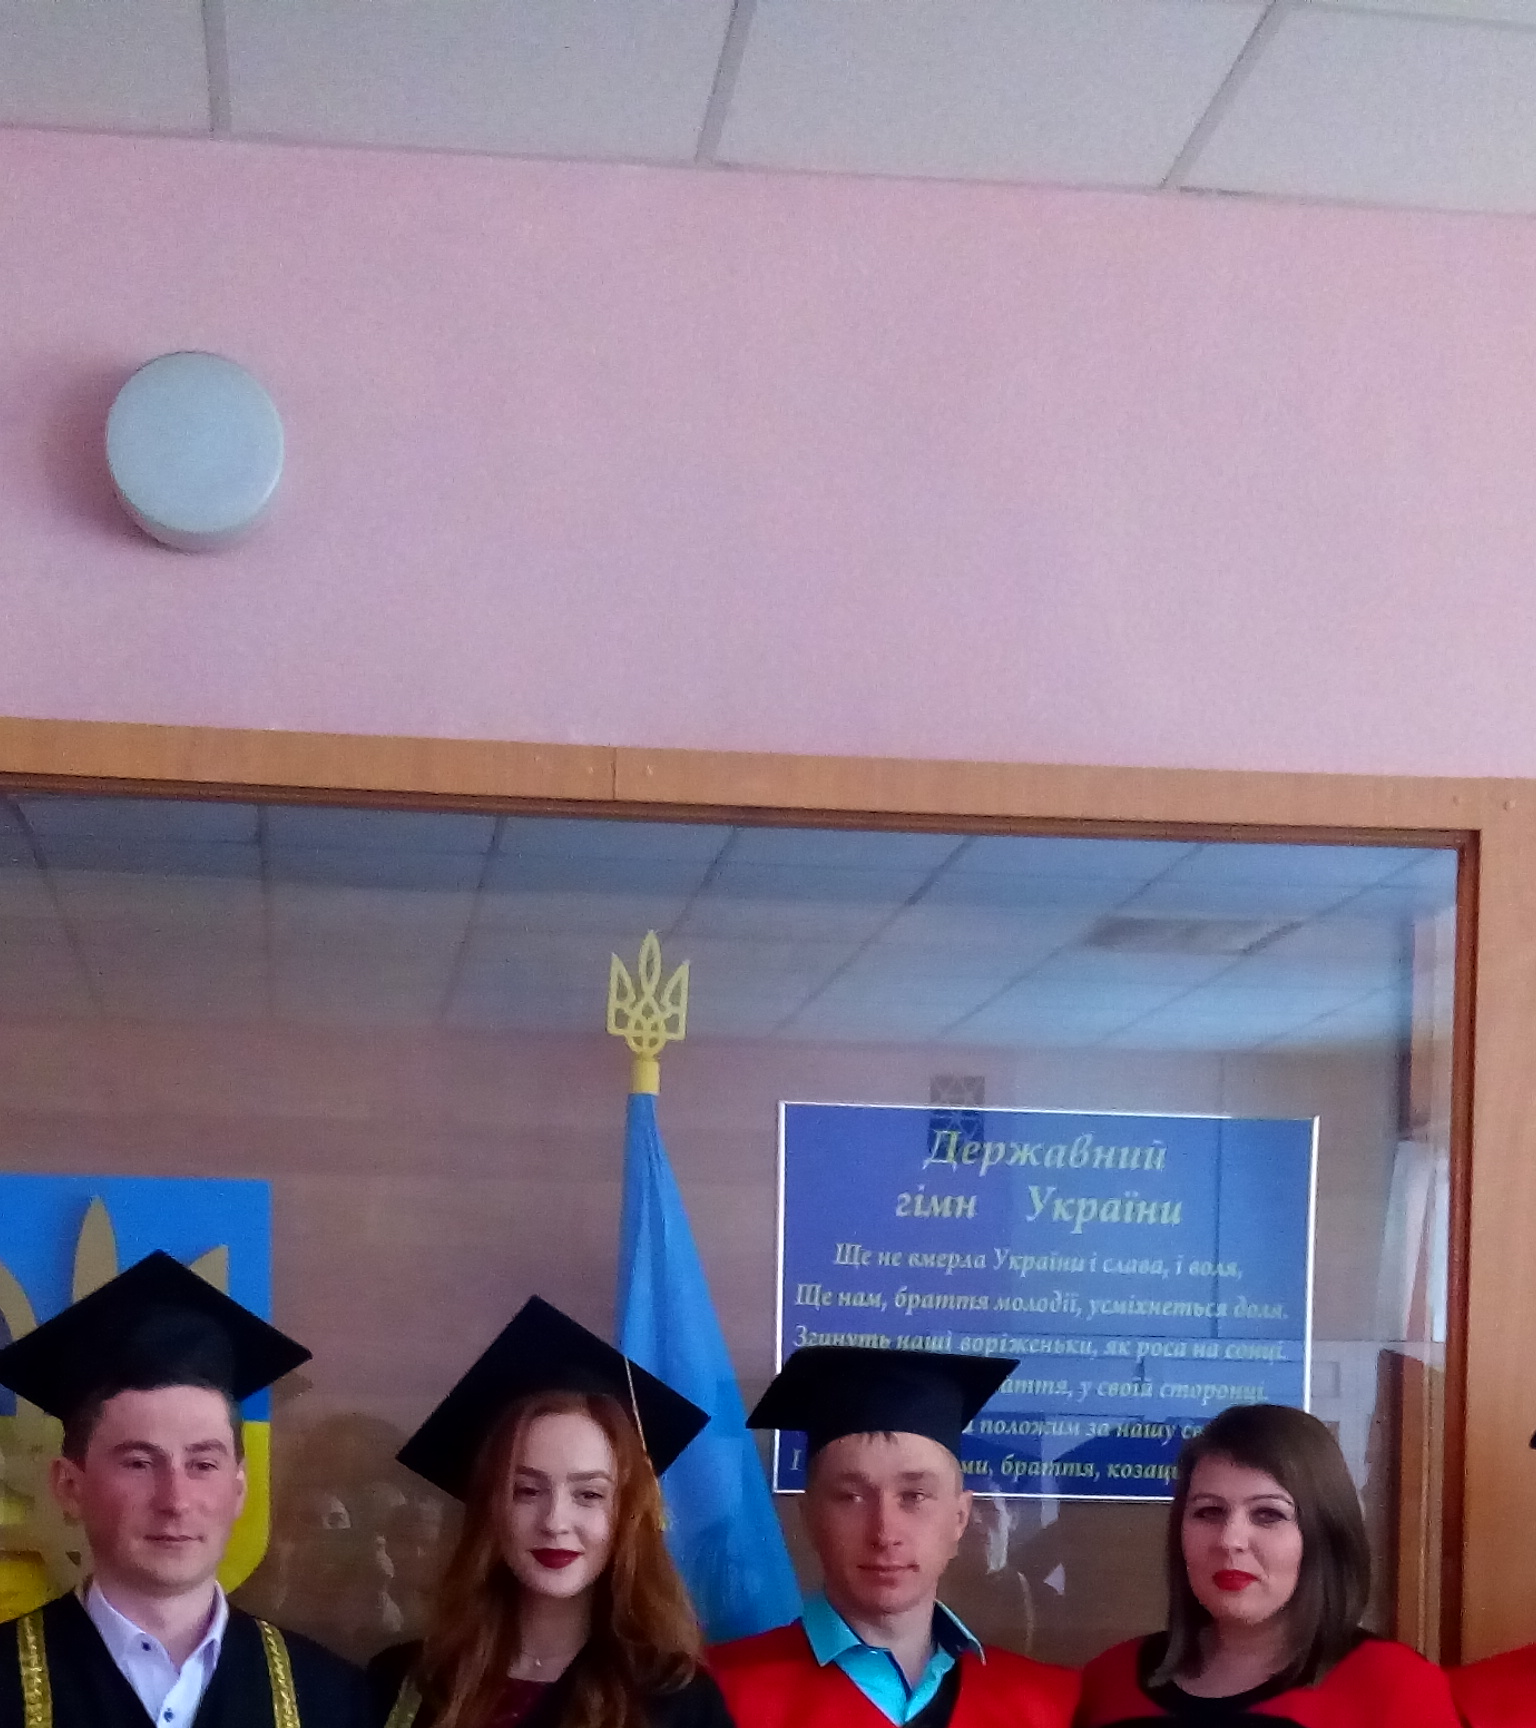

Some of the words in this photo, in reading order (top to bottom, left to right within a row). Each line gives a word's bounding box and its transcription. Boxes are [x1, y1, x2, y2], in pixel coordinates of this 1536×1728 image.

[922, 1130, 1167, 1177] Державний
[895, 1184, 978, 1219] гімн
[1026, 1185, 1182, 1234] України
[834, 1242, 871, 1270] Ще
[878, 1249, 902, 1267] не
[908, 1250, 987, 1275] вмерла
[993, 1247, 1084, 1278] України
[1103, 1256, 1168, 1279] слава,
[1188, 1260, 1243, 1280] воля,
[795, 1283, 833, 1311] Ще
[837, 1291, 888, 1312] нам,
[894, 1285, 989, 1315] браття
[993, 1290, 1082, 1318] молодії,
[1087, 1294, 1228, 1320] усміхнеться
[793, 1325, 892, 1349] Згинуть
[895, 1330, 952, 1351] наші
[960, 1333, 1098, 1361] воріженьки,
[1103, 1341, 1131, 1356] як
[1136, 1341, 1188, 1363] роса
[1193, 1342, 1218, 1358] на
[999, 1379, 1073, 1399] аття,
[1078, 1381, 1092, 1402] у
[979, 1420, 1079, 1437] положим
[1085, 1423, 1110, 1437] за
[1117, 1424, 1176, 1446] нашу
[1001, 1454, 1101, 1482] браття,
